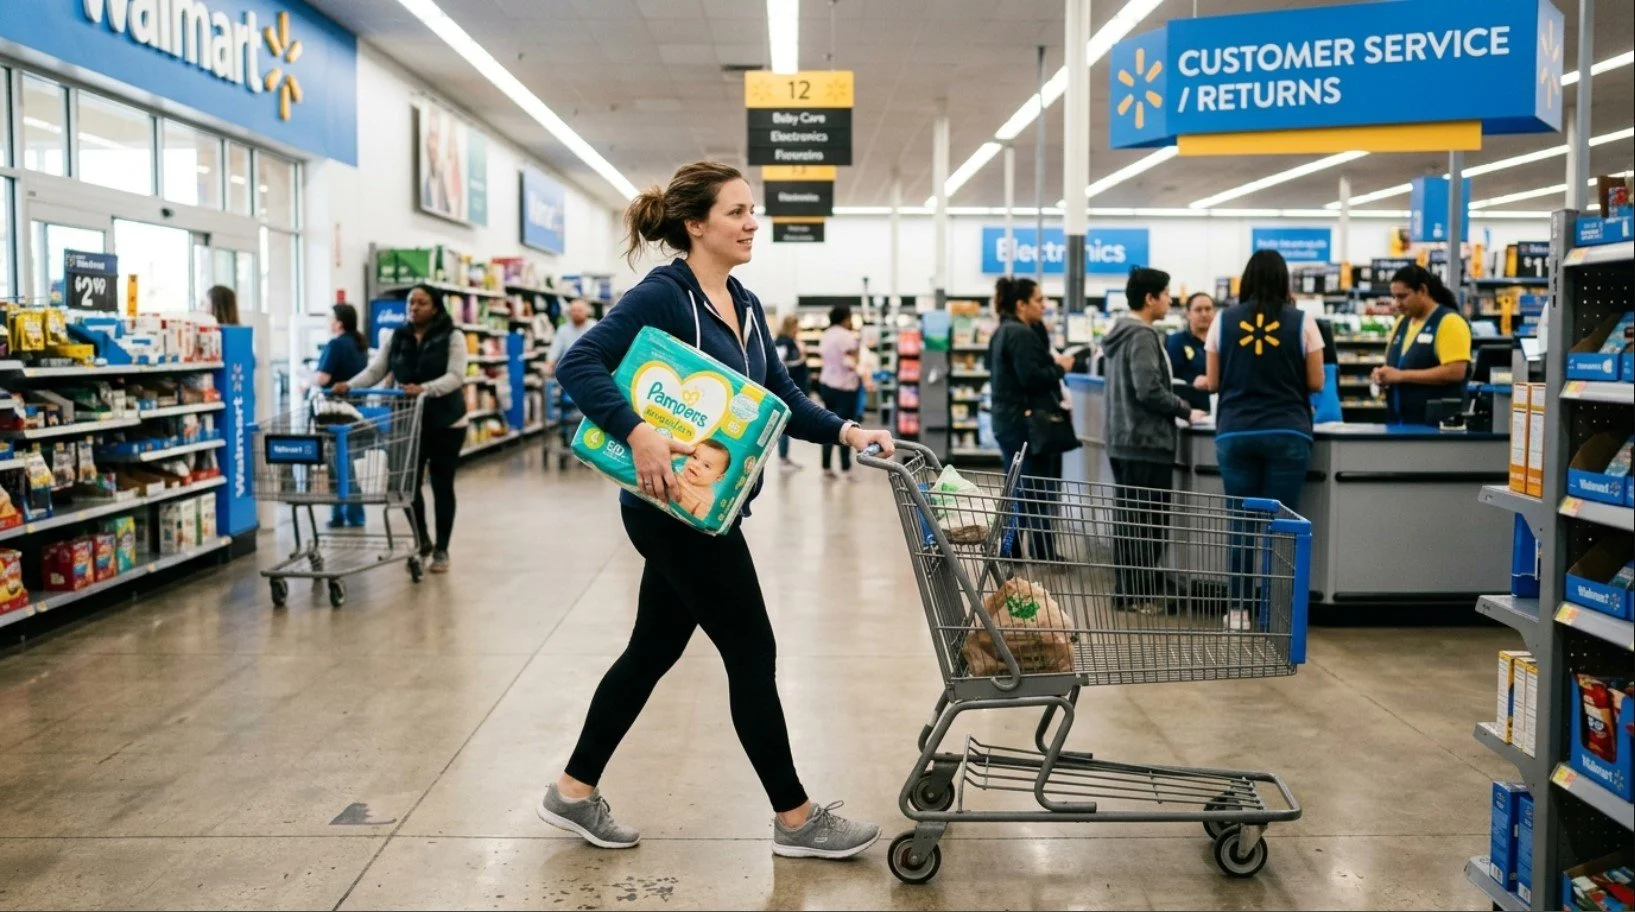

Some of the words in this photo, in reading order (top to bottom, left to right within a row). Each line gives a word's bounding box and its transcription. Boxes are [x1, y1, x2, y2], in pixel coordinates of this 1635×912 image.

[1178, 38, 1355, 77] CUSTOMER
[1364, 26, 1511, 64] SERVICE
[788, 80, 811, 100] 12
[1177, 87, 1190, 113] /
[1197, 76, 1342, 112] RETURNS
[996, 237, 1127, 263] Electrnics
[646, 381, 708, 428] Pampers
